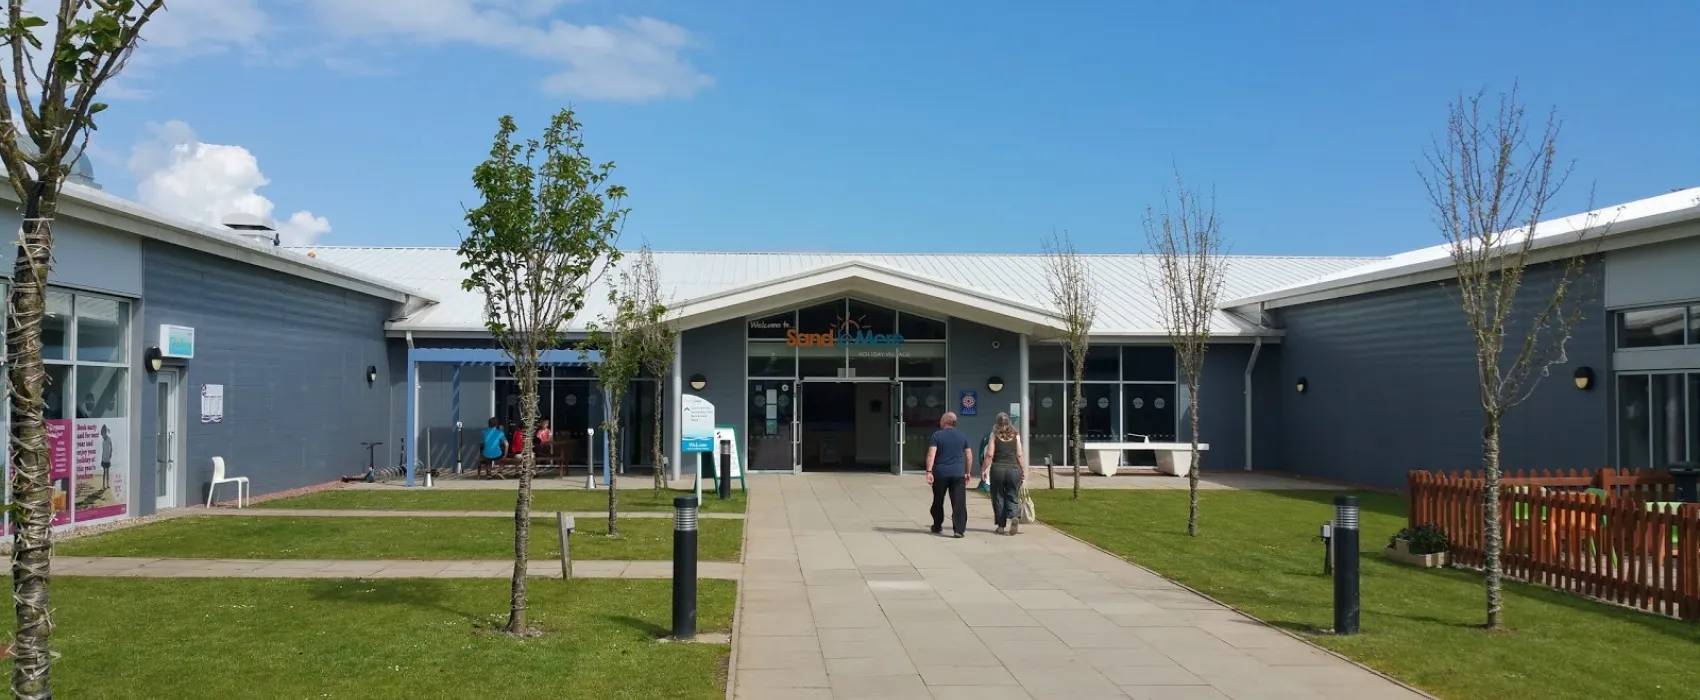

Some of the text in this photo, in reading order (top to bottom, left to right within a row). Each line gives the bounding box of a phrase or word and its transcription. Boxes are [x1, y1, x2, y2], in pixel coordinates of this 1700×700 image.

[750, 320, 790, 329] Welcome to
[786, 328, 834, 347] Sand
[855, 329, 904, 347] Mere
